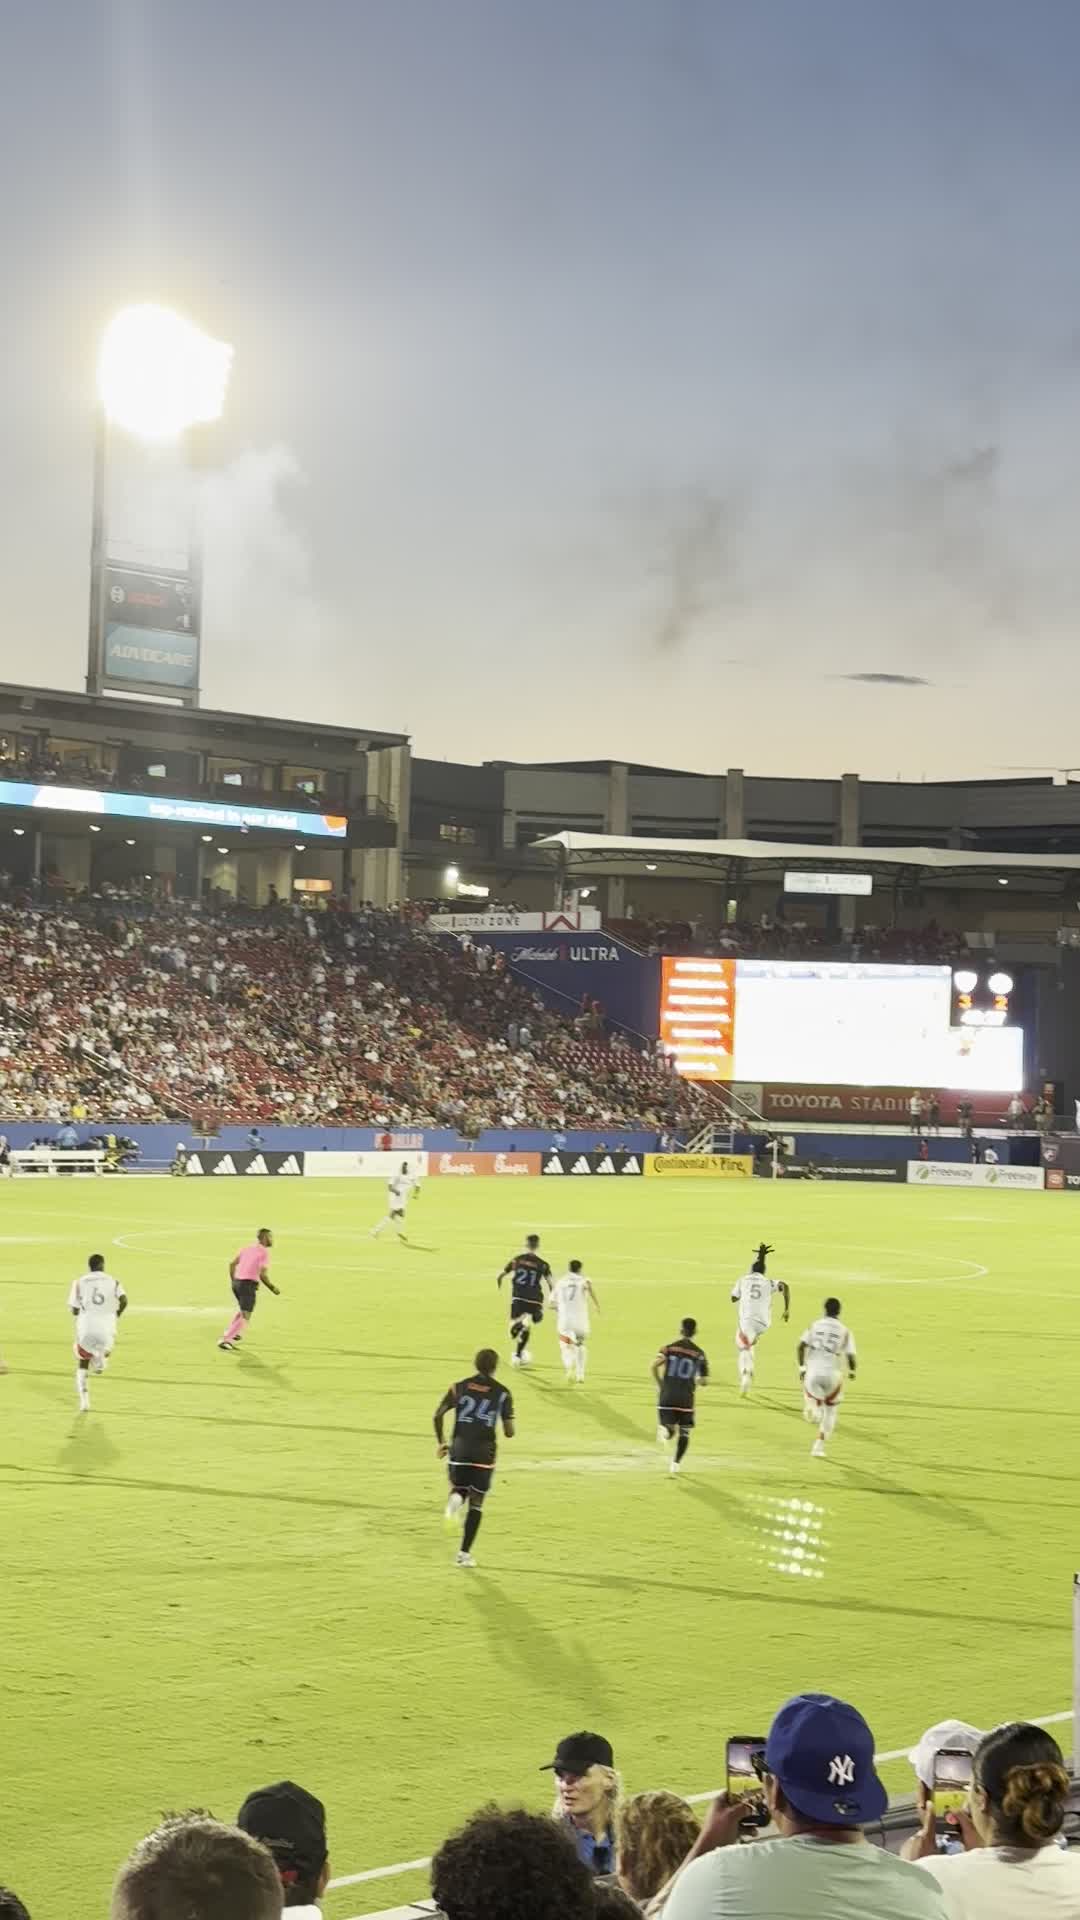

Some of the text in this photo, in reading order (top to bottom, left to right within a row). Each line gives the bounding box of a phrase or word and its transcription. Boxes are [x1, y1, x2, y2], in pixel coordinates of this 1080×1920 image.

[489, 915, 520, 928] ZONE
[570, 946, 620, 961] ULTRA
[769, 1094, 843, 1110] TOYOTA
[515, 1268, 537, 1286] 21
[92, 1286, 104, 1306] 6
[567, 1284, 577, 1301] 7
[750, 1284, 762, 1300] 5
[668, 1354, 694, 1379] 10
[457, 1395, 496, 1427] 24
[827, 1754, 856, 1786] NY
